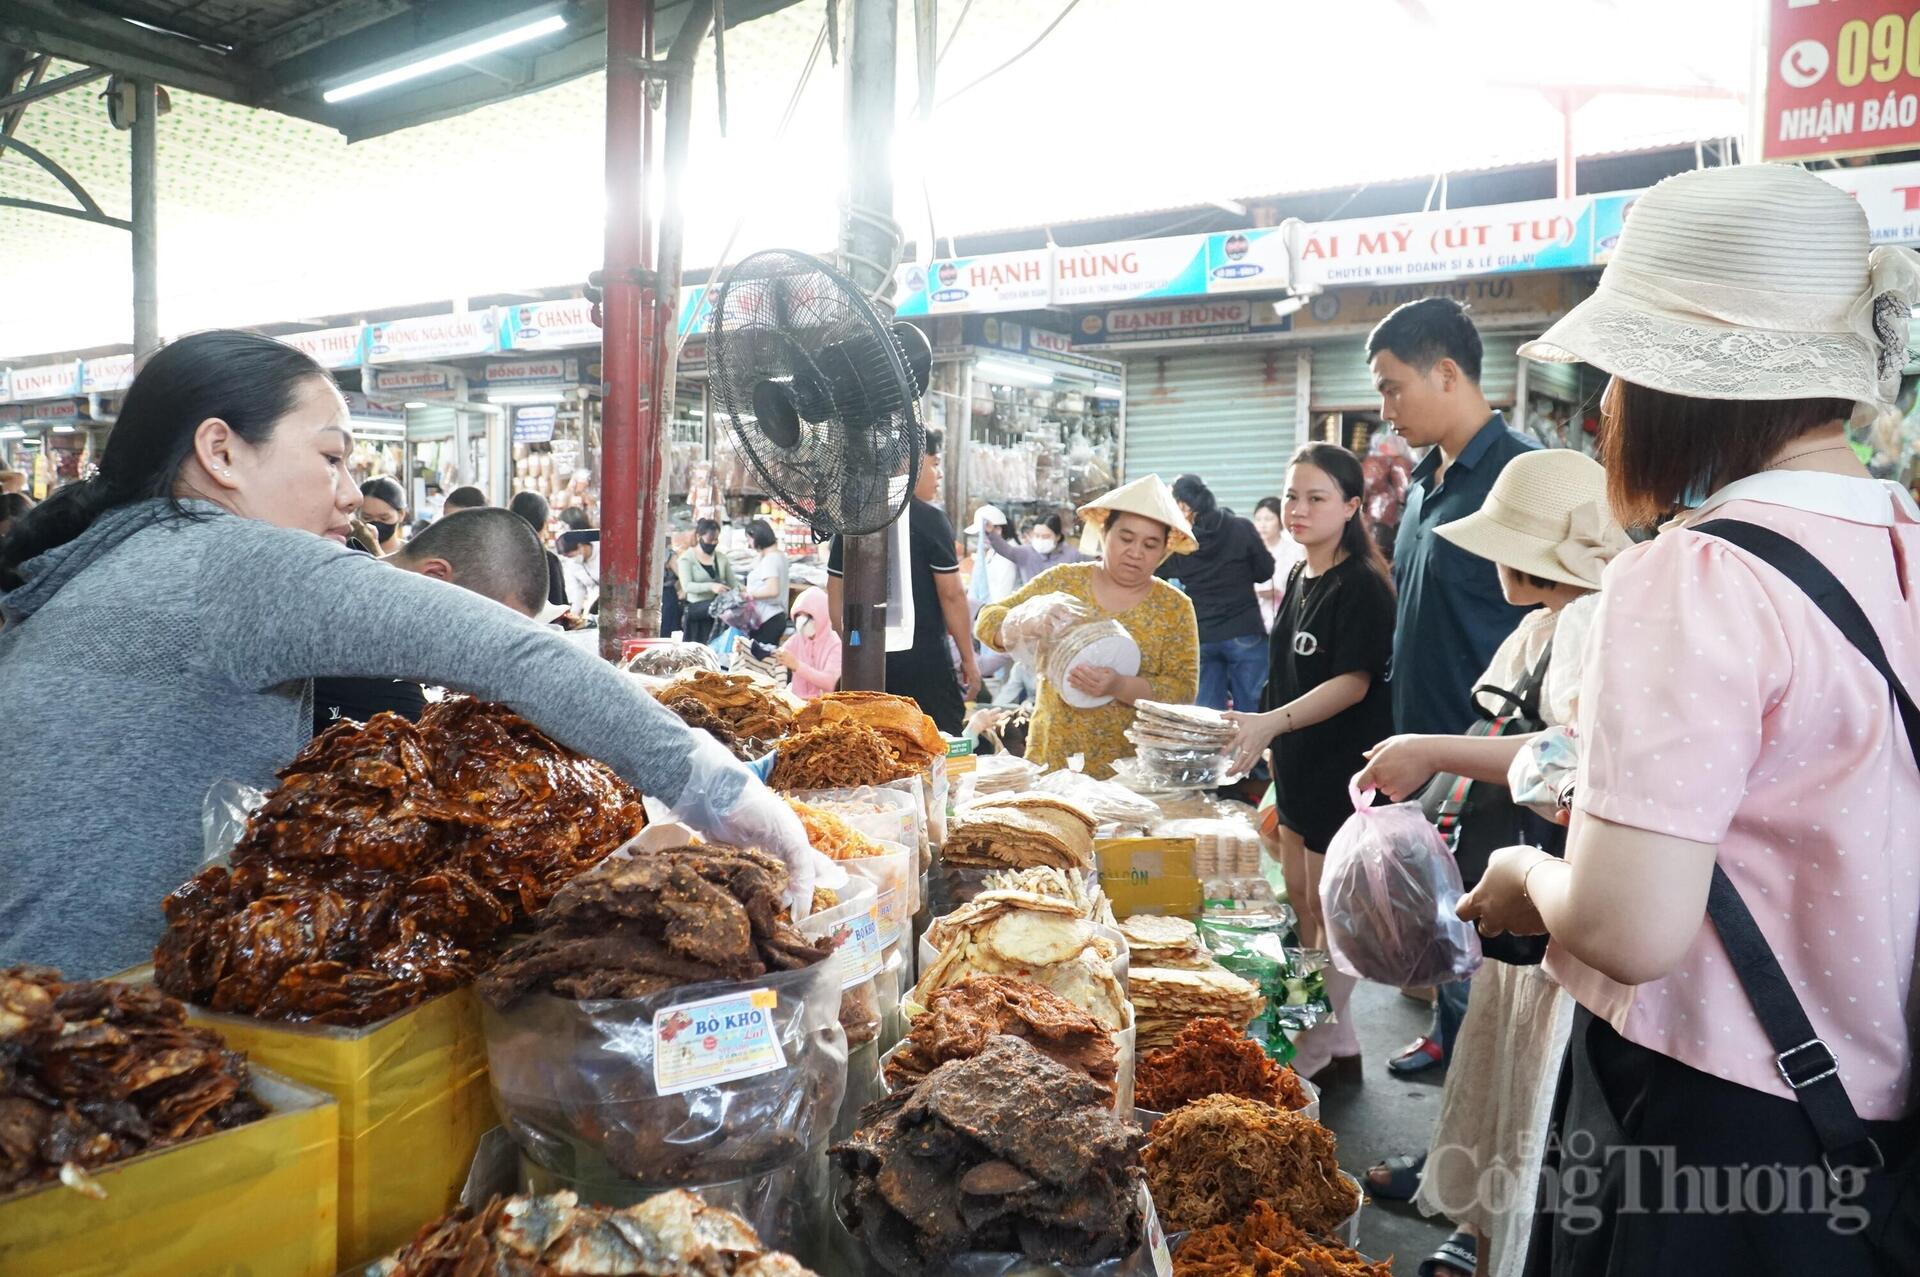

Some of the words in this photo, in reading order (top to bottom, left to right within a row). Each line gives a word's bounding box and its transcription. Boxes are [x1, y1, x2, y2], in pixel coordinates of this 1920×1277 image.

[1779, 98, 1855, 143] NHẬN
[1861, 90, 1917, 132] BÁO
[970, 261, 1041, 292] HẠNH
[1059, 249, 1139, 280] HÙNG
[1376, 264, 1402, 276] KINH
[1407, 260, 1447, 273] DOANH
[695, 1014, 720, 1035] BÒ
